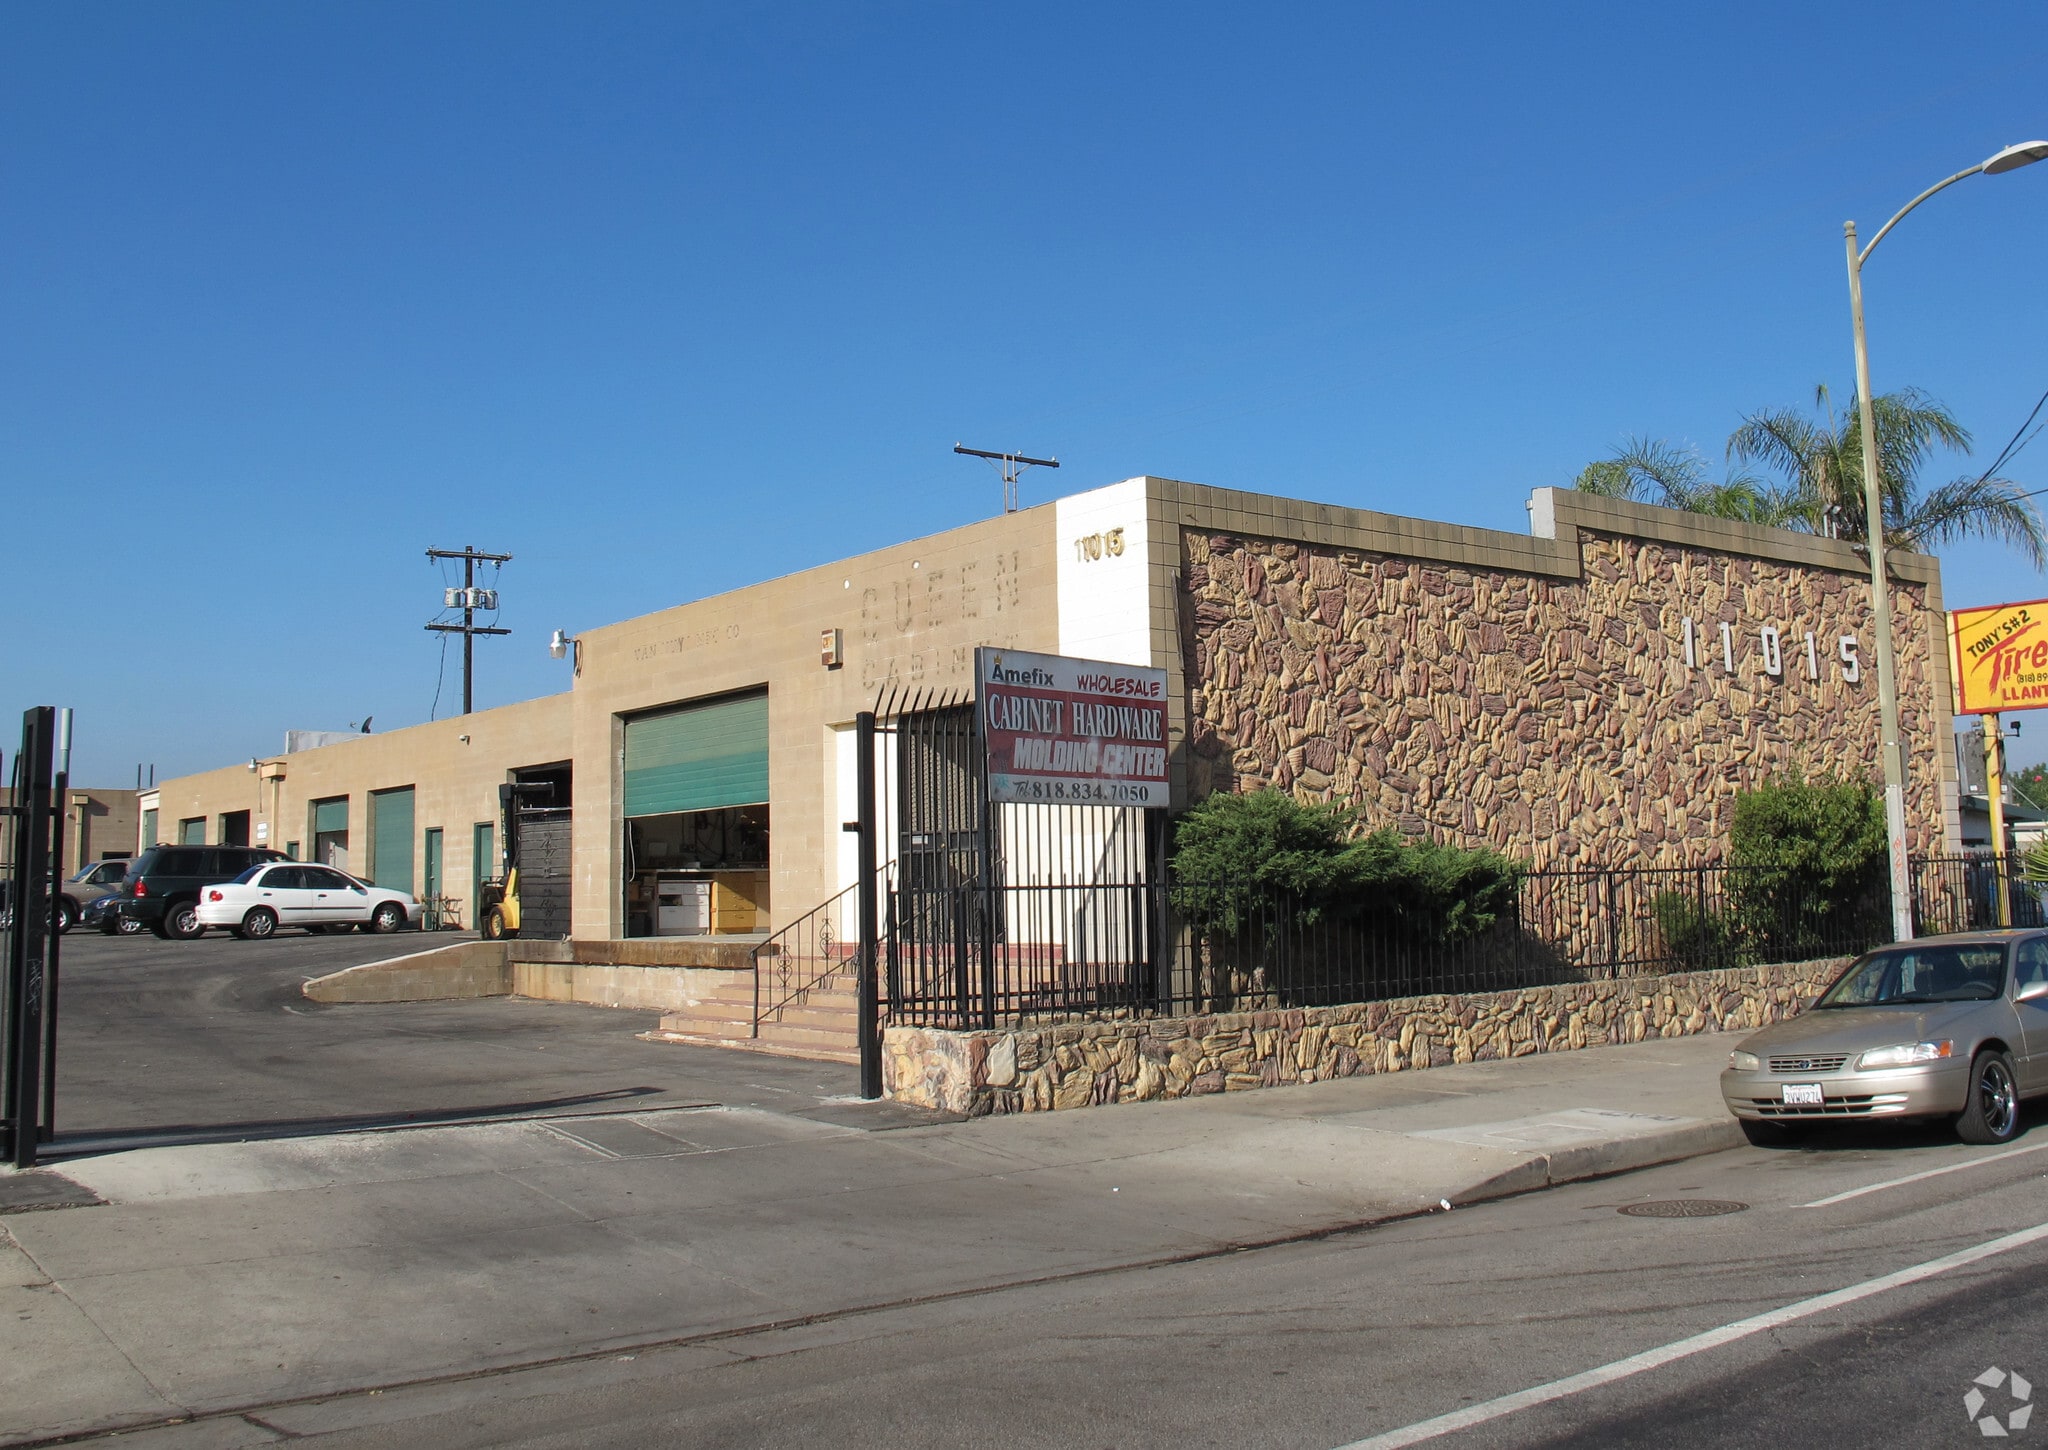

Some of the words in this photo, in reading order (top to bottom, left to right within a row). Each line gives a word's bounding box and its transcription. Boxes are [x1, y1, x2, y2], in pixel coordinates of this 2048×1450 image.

[1966, 622, 2013, 657] TONY'S
[2009, 609, 2031, 629] #2
[1681, 616, 1859, 683] 11015
[992, 664, 1054, 687] Amefix
[1077, 674, 1161, 697] WHOLESALE
[2017, 672, 2035, 684] (818)
[989, 693, 1064, 734] CABINET
[1072, 701, 1163, 741] HARDWARE
[1013, 737, 1099, 774] MOLDING
[1102, 744, 1166, 777] CENTER
[1032, 781, 1149, 801] 818.834.7050
